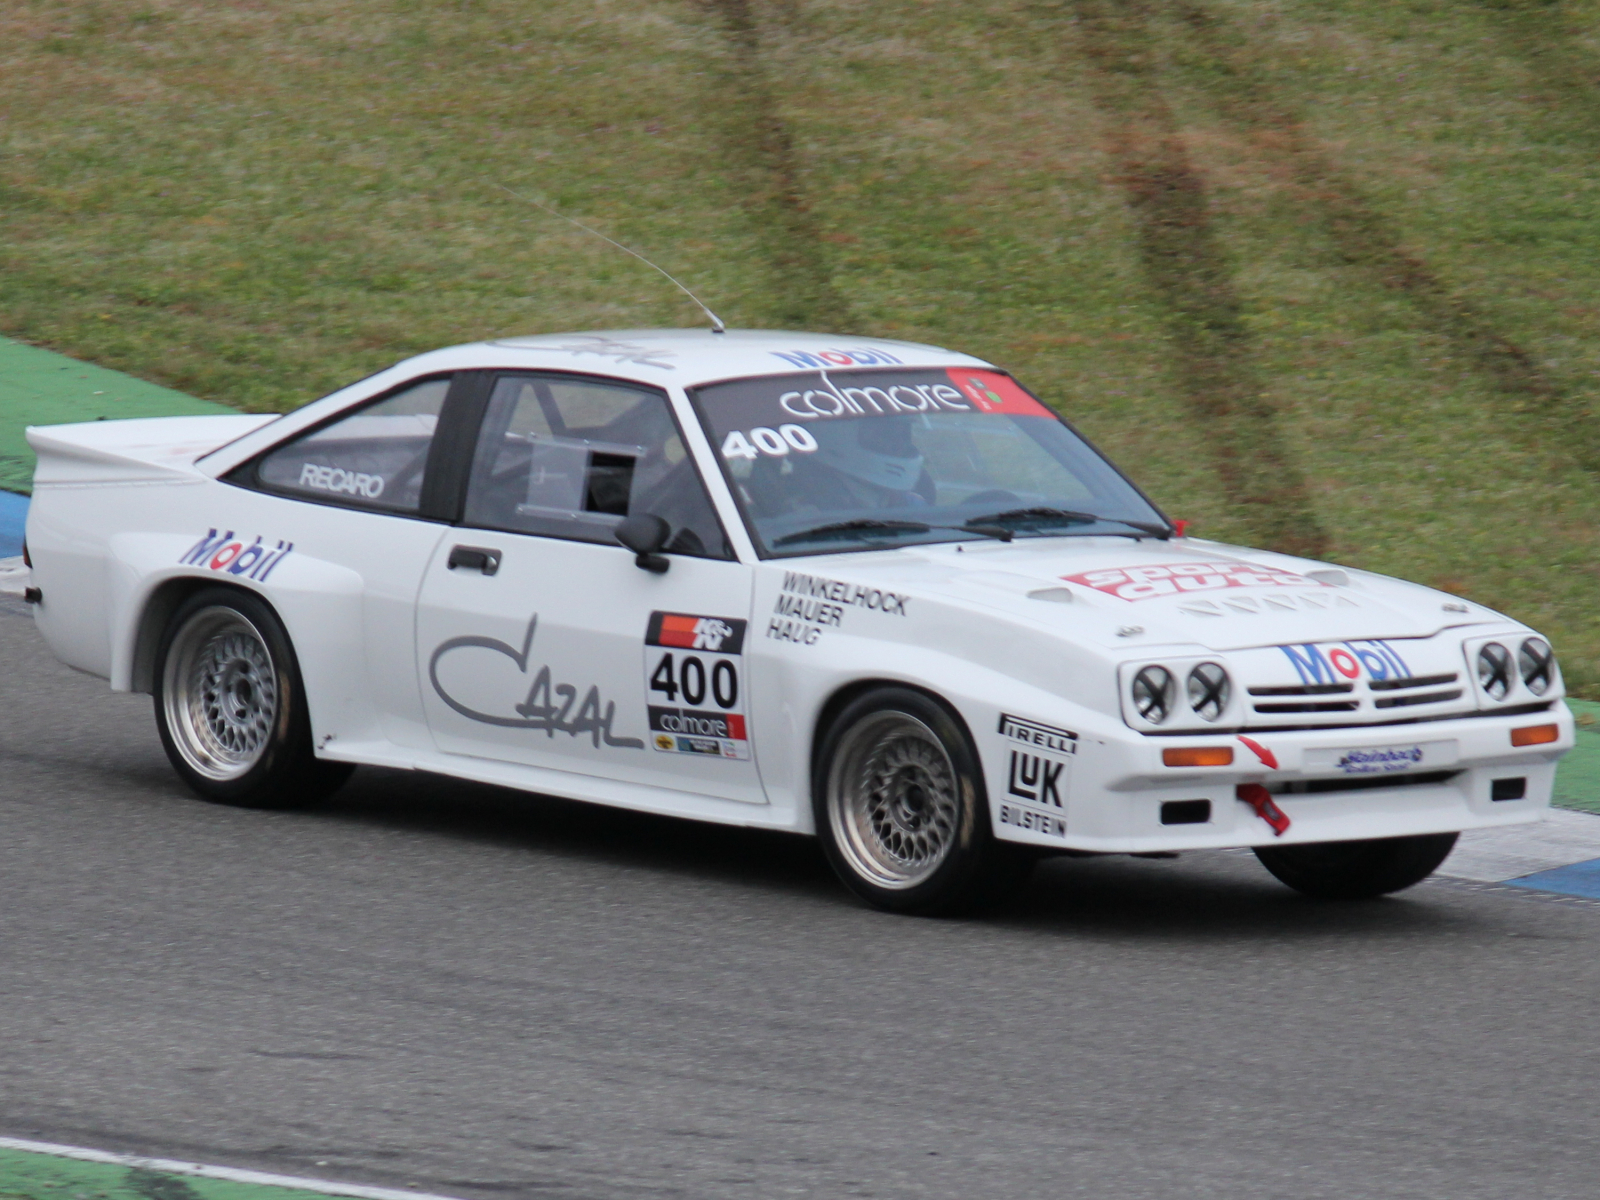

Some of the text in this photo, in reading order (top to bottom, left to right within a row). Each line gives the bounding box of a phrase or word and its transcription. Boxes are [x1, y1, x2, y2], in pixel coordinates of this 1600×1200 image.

[768, 346, 905, 369] Mobil
[779, 369, 971, 418] colmore
[721, 423, 819, 460] 400
[299, 463, 385, 498] RECARO
[178, 527, 293, 583] Mobil
[782, 570, 911, 617] WINKELHOCK
[1116, 573, 1321, 599] auto
[773, 593, 844, 628] MAUER
[766, 617, 822, 645] HAUG
[650, 652, 738, 709] 400
[1278, 640, 1415, 684] Mobil
[429, 612, 645, 750] CAZAL
[660, 708, 728, 738] colmore
[998, 711, 1078, 755] PIRELLI
[1001, 804, 1067, 839] BILSTEIN
